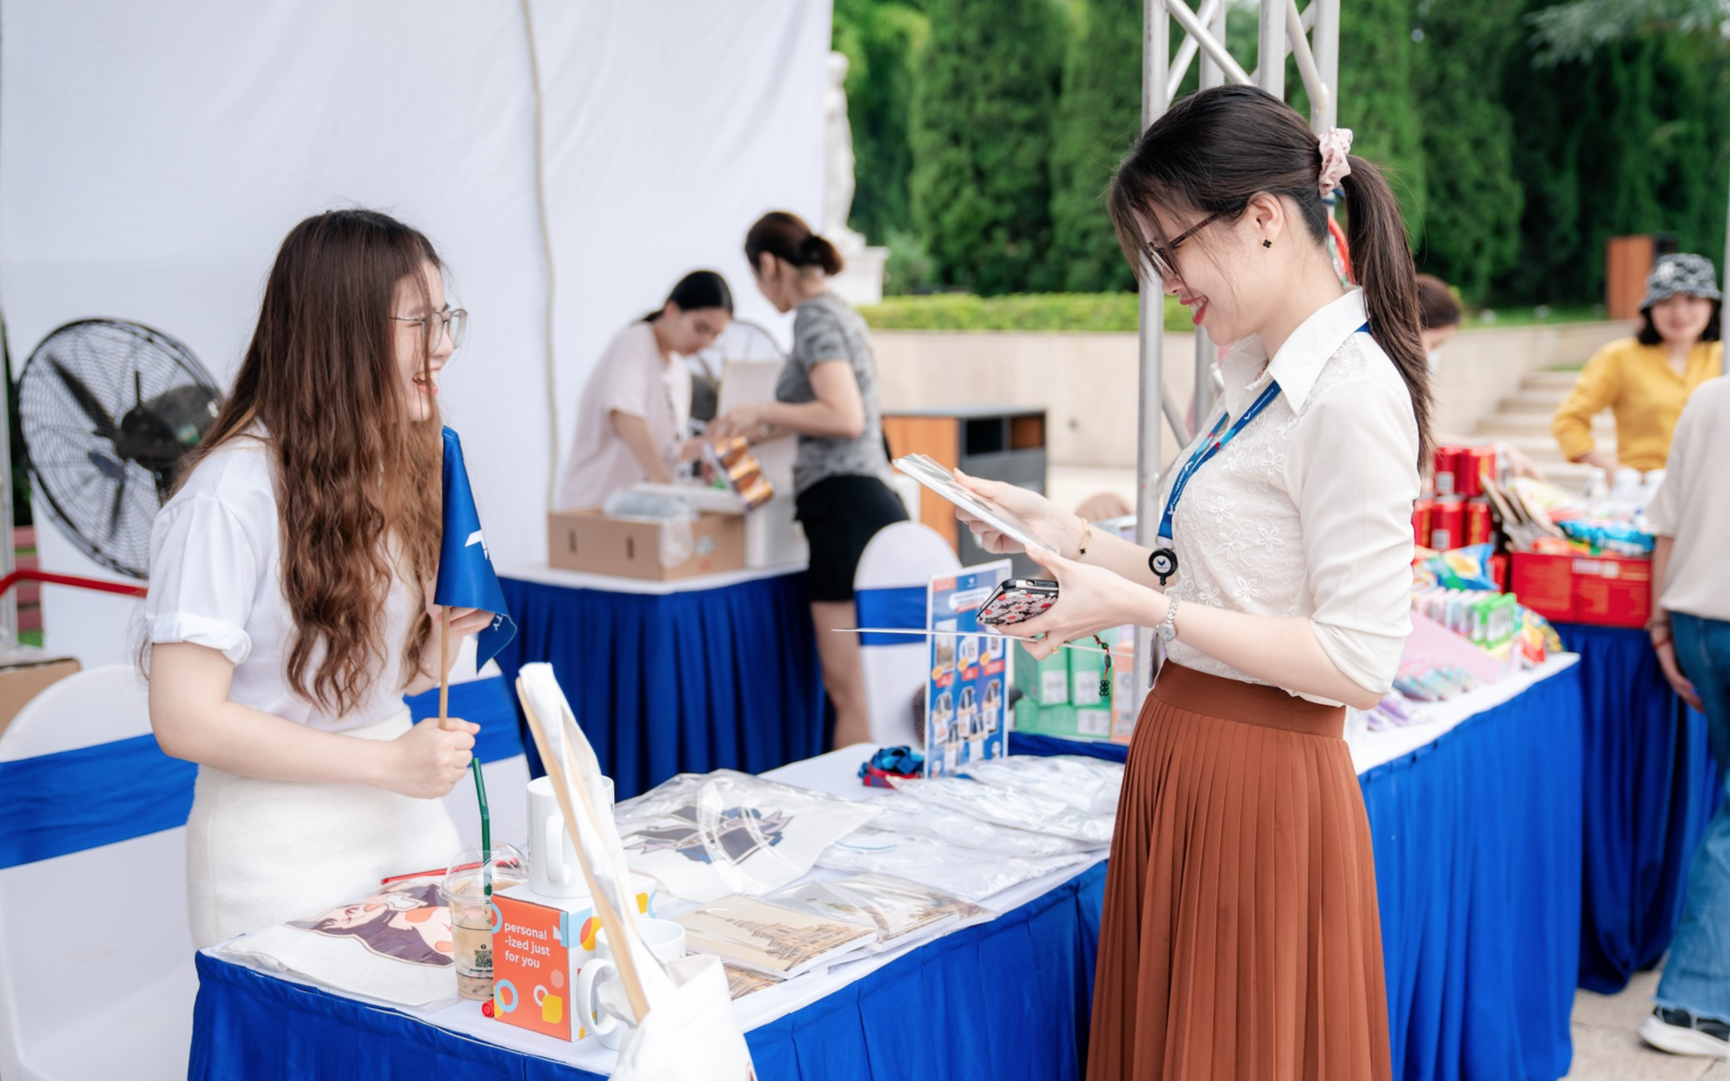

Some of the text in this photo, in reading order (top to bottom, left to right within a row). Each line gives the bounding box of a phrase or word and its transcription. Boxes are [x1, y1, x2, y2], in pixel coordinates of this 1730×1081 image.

[504, 922, 547, 940] personal
[505, 935, 550, 956] -ized just
[505, 950, 540, 968] for you
